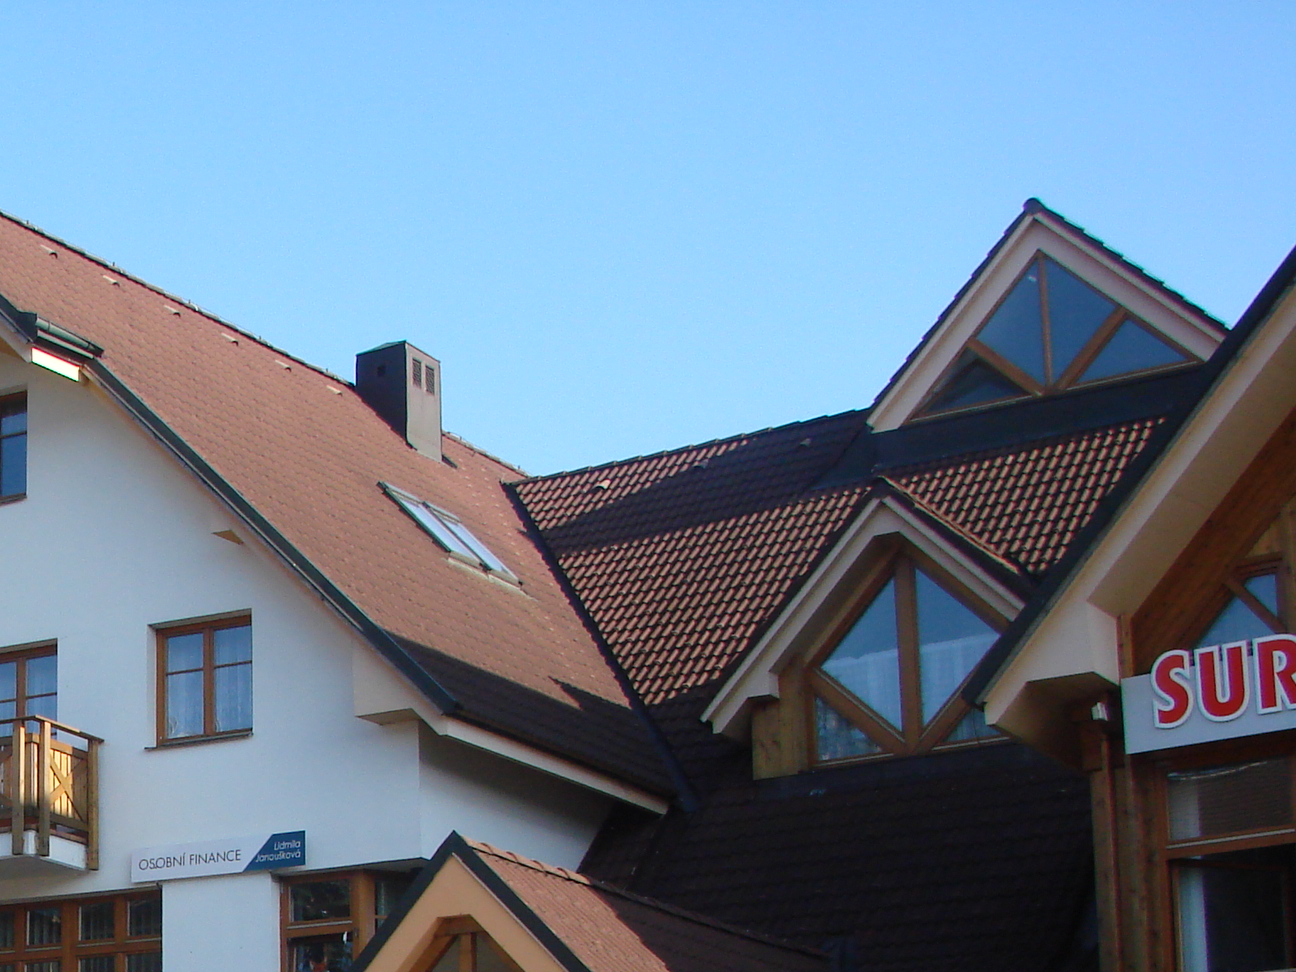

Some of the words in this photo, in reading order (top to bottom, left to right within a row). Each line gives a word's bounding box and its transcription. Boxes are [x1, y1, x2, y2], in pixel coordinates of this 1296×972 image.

[1151, 634, 1296, 729] SUR
[138, 853, 186, 871] OSOBNÍ
[189, 849, 242, 866] FINANCE
